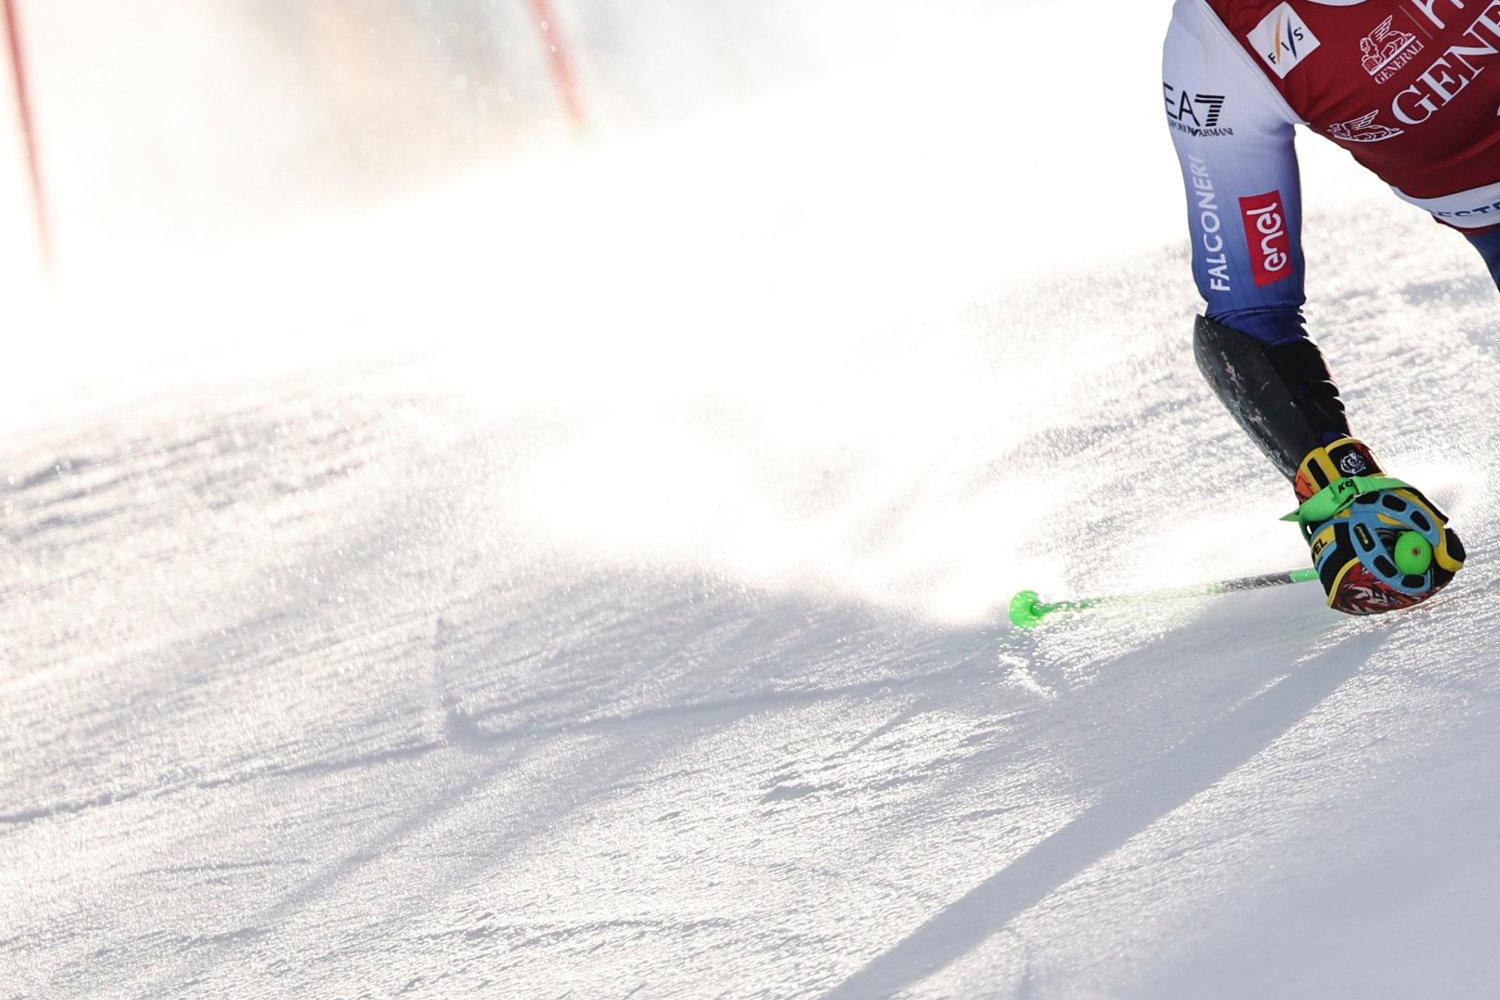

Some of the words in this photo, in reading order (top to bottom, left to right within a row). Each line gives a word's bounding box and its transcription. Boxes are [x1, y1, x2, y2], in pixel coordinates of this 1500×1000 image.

[1267, 27, 1304, 65] FIS
[1374, 40, 1425, 85] GENERALI
[1163, 82, 1225, 127] EA7
[1187, 154, 1231, 292] FALCONERI
[1246, 202, 1287, 272] enel
